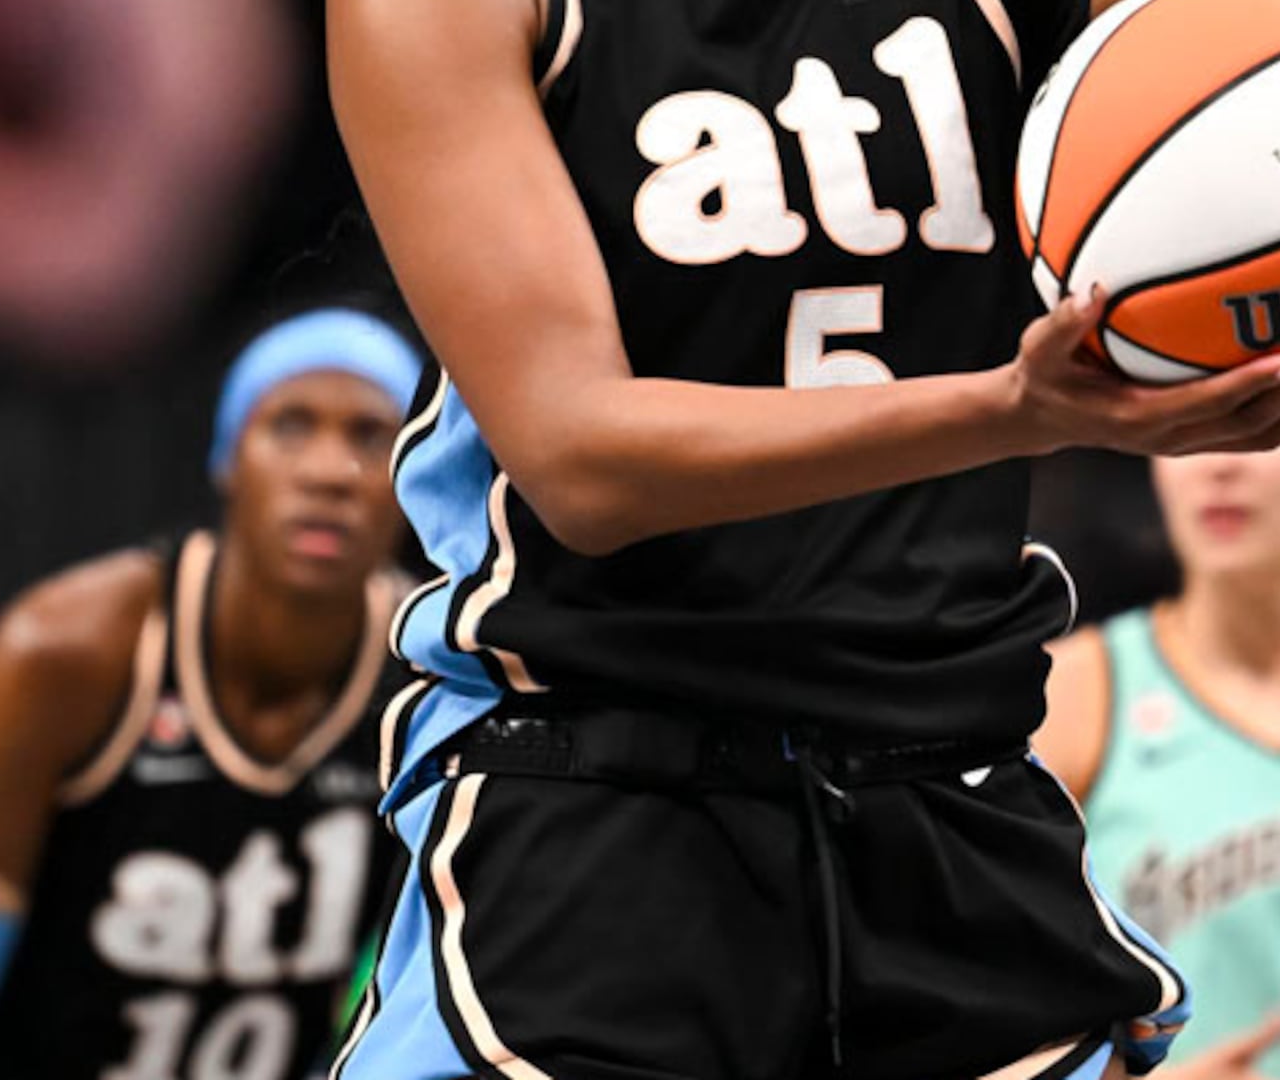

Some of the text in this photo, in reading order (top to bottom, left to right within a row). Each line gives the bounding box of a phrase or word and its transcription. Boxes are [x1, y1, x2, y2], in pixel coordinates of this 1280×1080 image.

[633, 16, 996, 265] atl
[90, 806, 372, 985] atl
[98, 989, 302, 1080] 10
